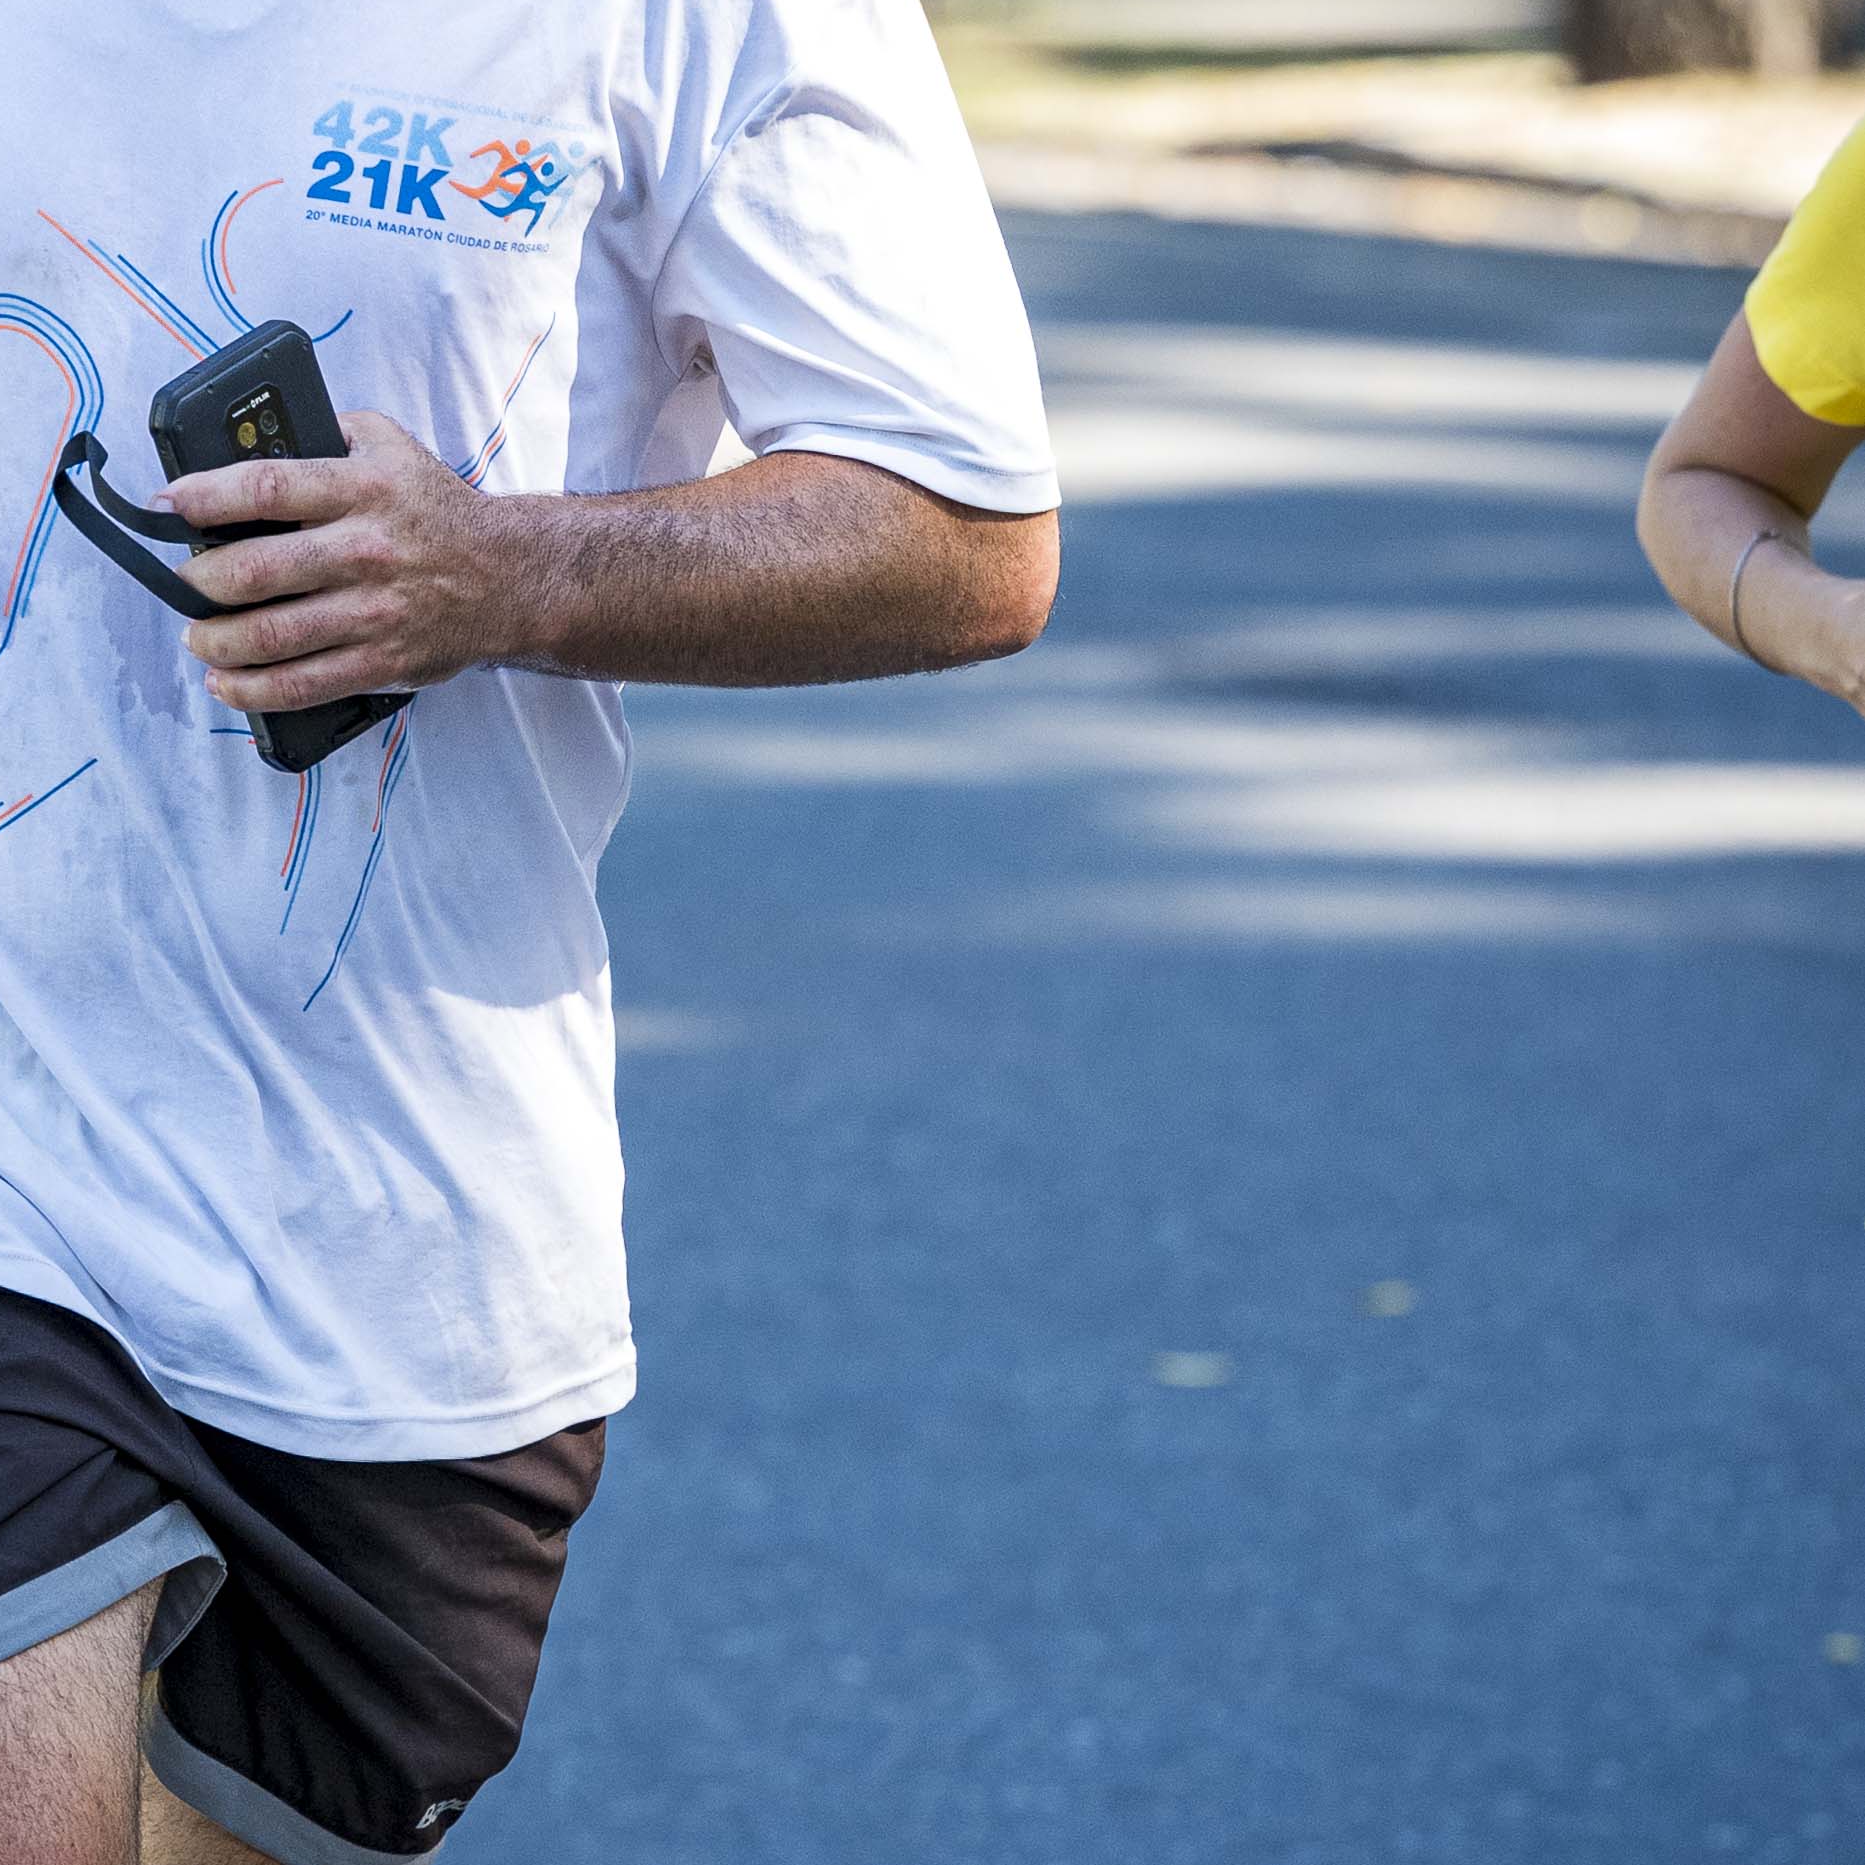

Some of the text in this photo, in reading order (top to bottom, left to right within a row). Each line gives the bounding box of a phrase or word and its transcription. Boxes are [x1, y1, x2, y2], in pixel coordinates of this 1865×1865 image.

[312, 99, 457, 168] 42K
[306, 150, 450, 221] 21K
[330, 213, 372, 229] MEDIA
[447, 232, 491, 250] CIUDAD
[493, 240, 509, 252] DE
